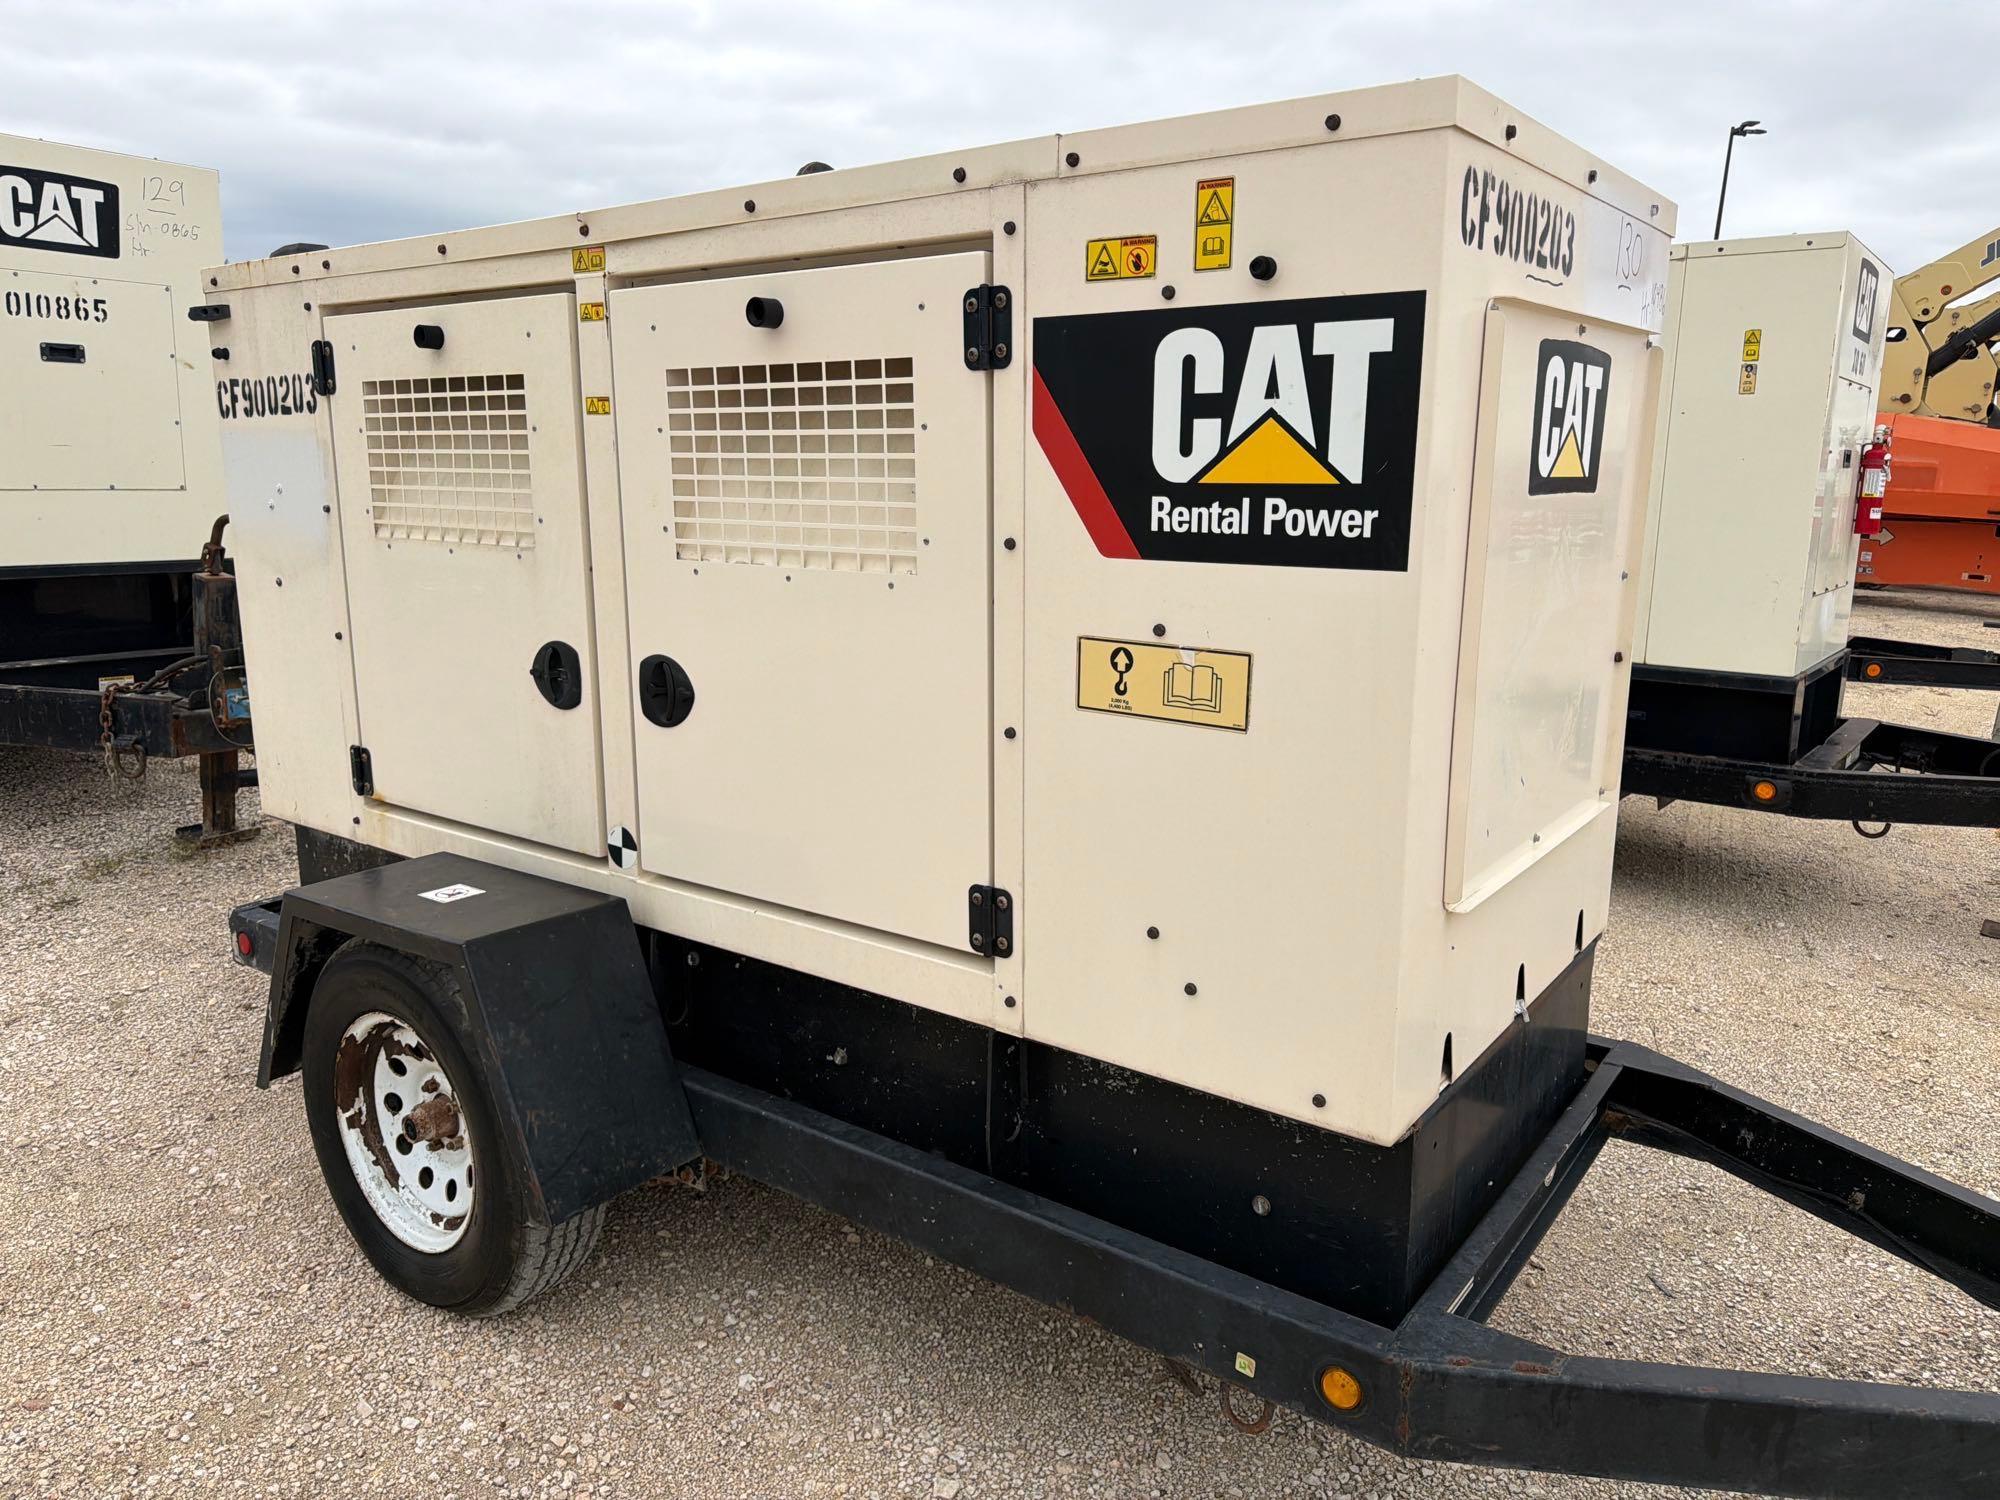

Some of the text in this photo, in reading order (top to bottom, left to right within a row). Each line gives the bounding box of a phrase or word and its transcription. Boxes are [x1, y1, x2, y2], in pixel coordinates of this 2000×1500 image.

[0, 175, 105, 248] CAT
[142, 176, 185, 206] 129
[1461, 165, 1575, 278] CF900203
[1615, 216, 1643, 280] 130
[5, 291, 108, 323] 010865
[1855, 267, 1878, 335] CAT
[217, 373, 318, 419] CF900203
[1152, 318, 1394, 484] CAT
[1538, 355, 1604, 478] CAT
[1151, 496, 1378, 538] Rental Power
